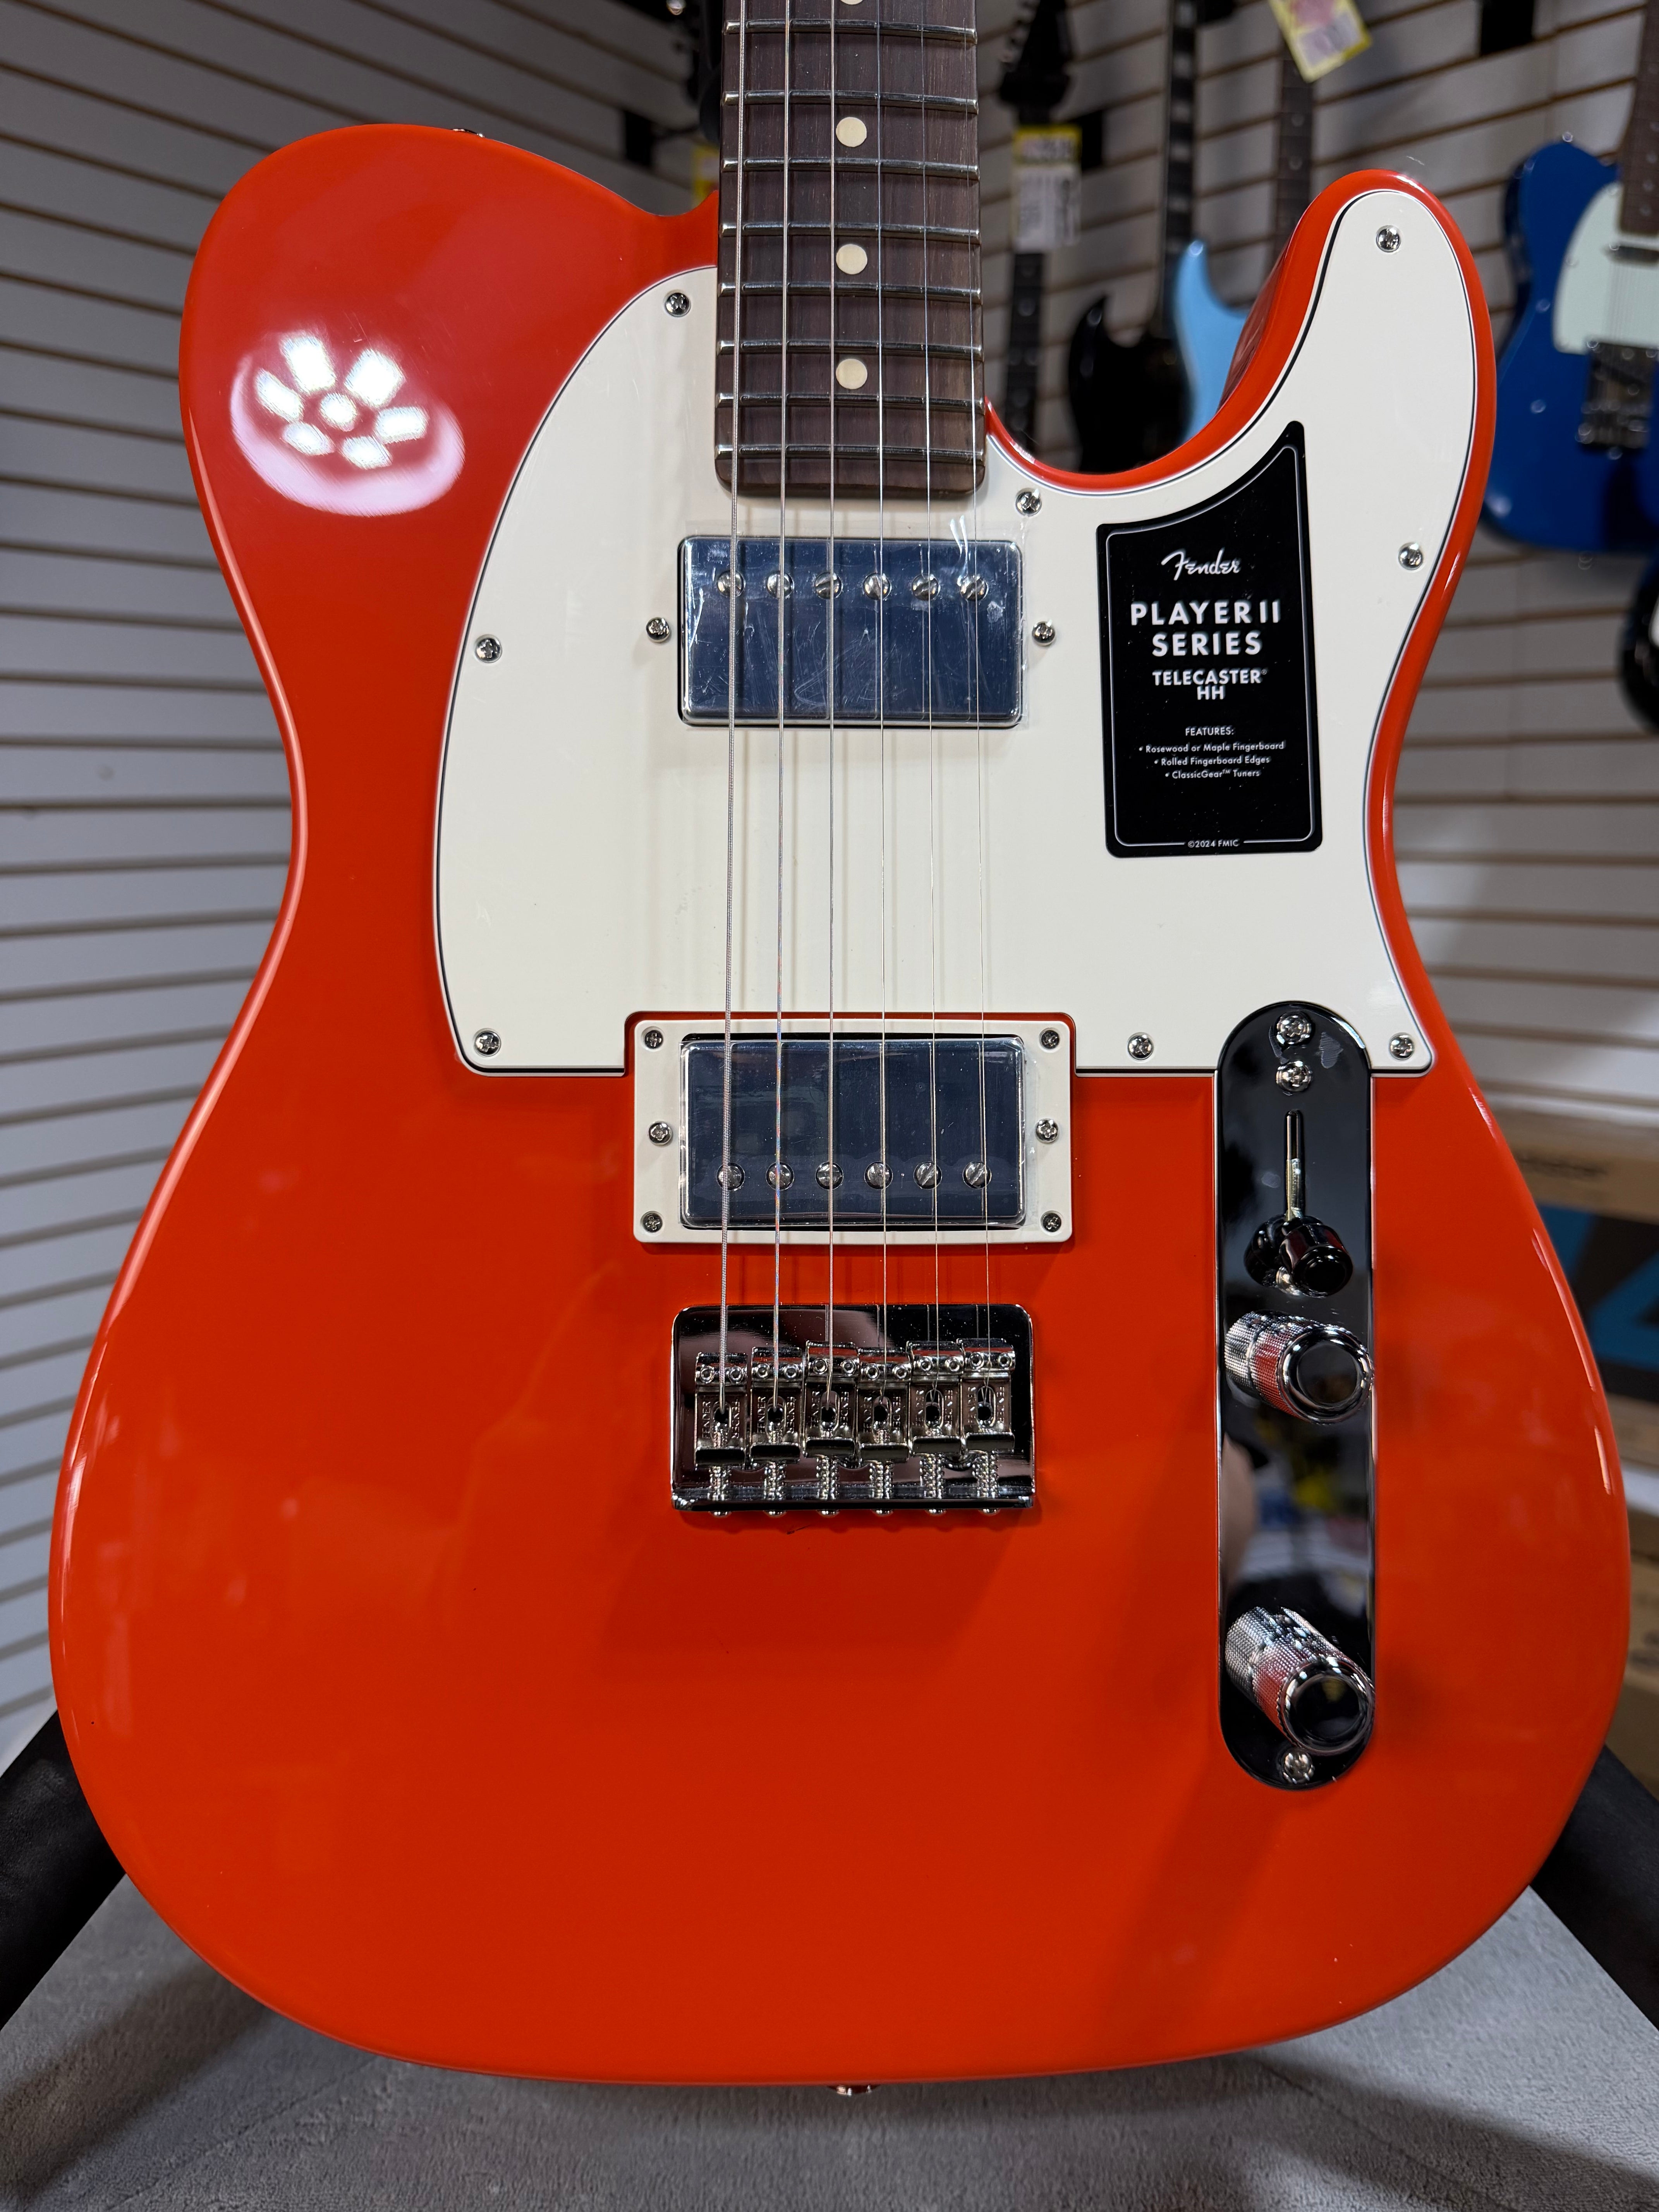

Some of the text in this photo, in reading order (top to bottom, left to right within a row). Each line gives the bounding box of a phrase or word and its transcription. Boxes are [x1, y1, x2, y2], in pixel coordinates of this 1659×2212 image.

[1161, 548, 1241, 580] Fender
[1131, 600, 1280, 625] PLAYER II
[1152, 631, 1262, 657] SERIES
[1197, 685, 1225, 700] HH
[1185, 726, 1234, 736] FEATURES:
[1146, 744, 1189, 753] Rosewood
[1203, 742, 1230, 753] Maple
[1233, 741, 1285, 752] Fingerboard
[1161, 755, 1271, 766] Rolled Fingerboard Edges
[1233, 769, 1260, 778] Tuners
[702, 1401, 711, 1438] FENDER
[732, 1401, 740, 1438] FENDER
[757, 1396, 766, 1433] FENDER
[787, 1396, 795, 1433] FENDER
